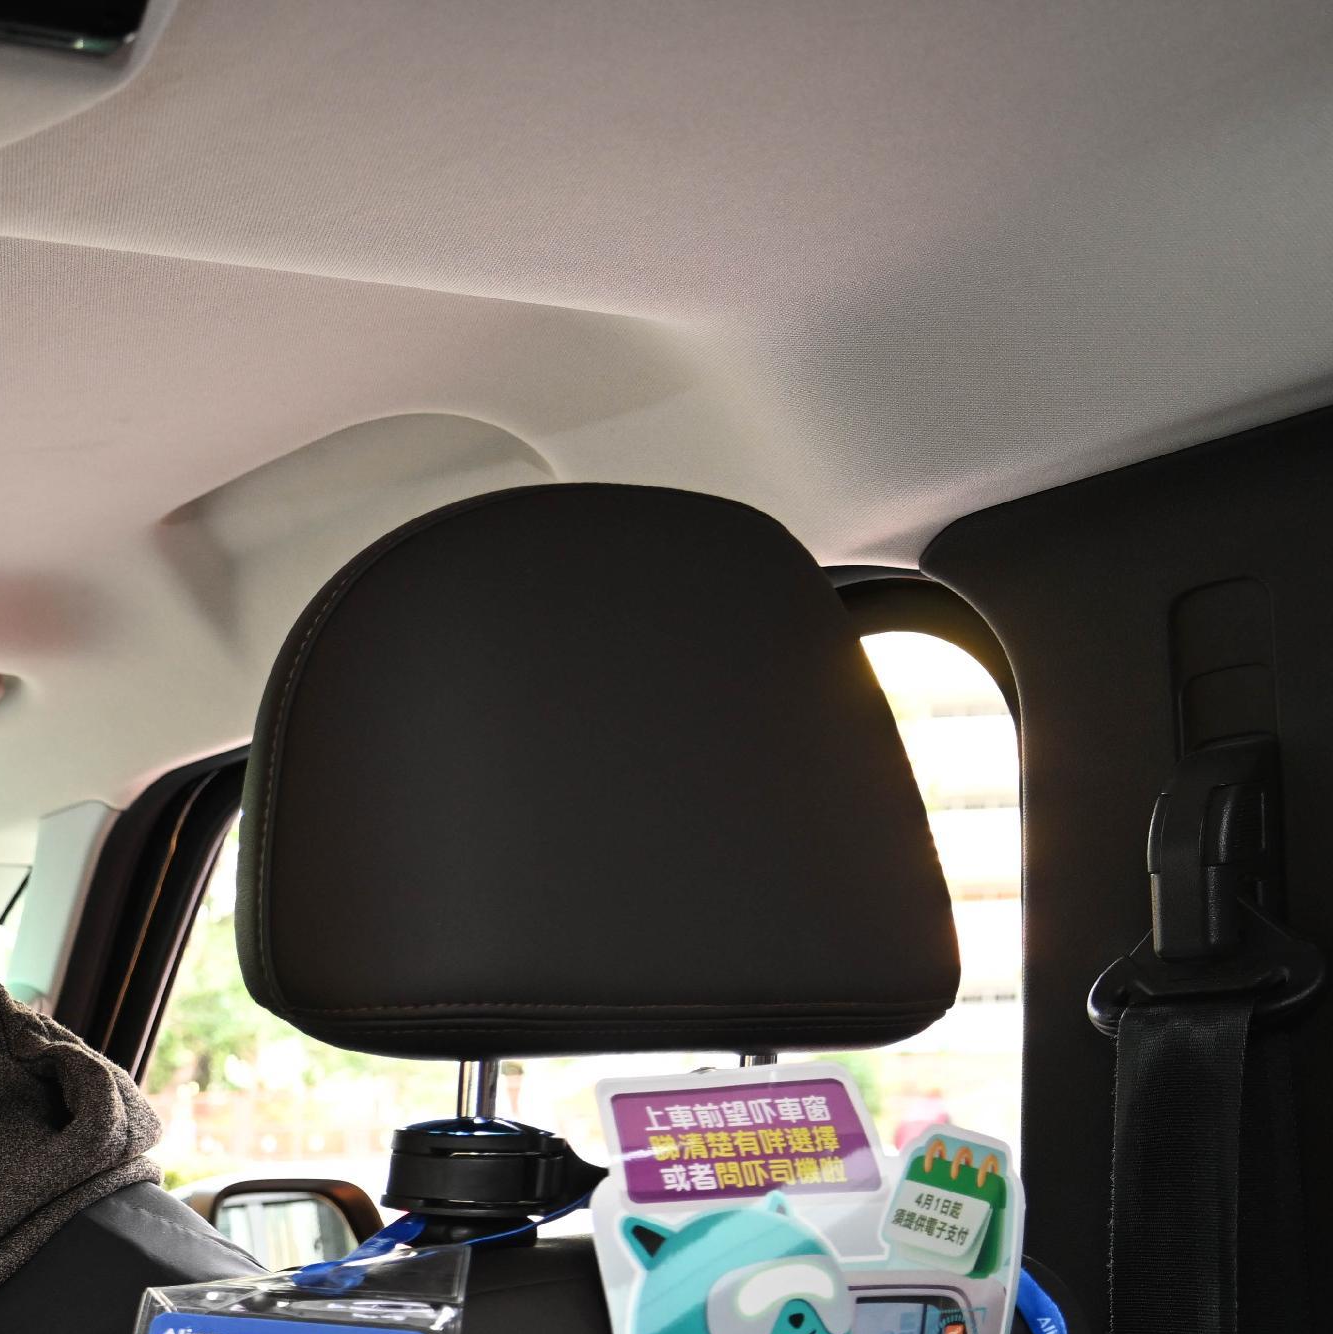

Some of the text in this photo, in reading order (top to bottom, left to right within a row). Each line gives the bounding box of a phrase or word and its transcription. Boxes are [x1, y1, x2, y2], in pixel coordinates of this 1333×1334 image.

[644, 1095, 832, 1133] 上車前望吓車窗
[914, 1189, 964, 1221] 4月1日起
